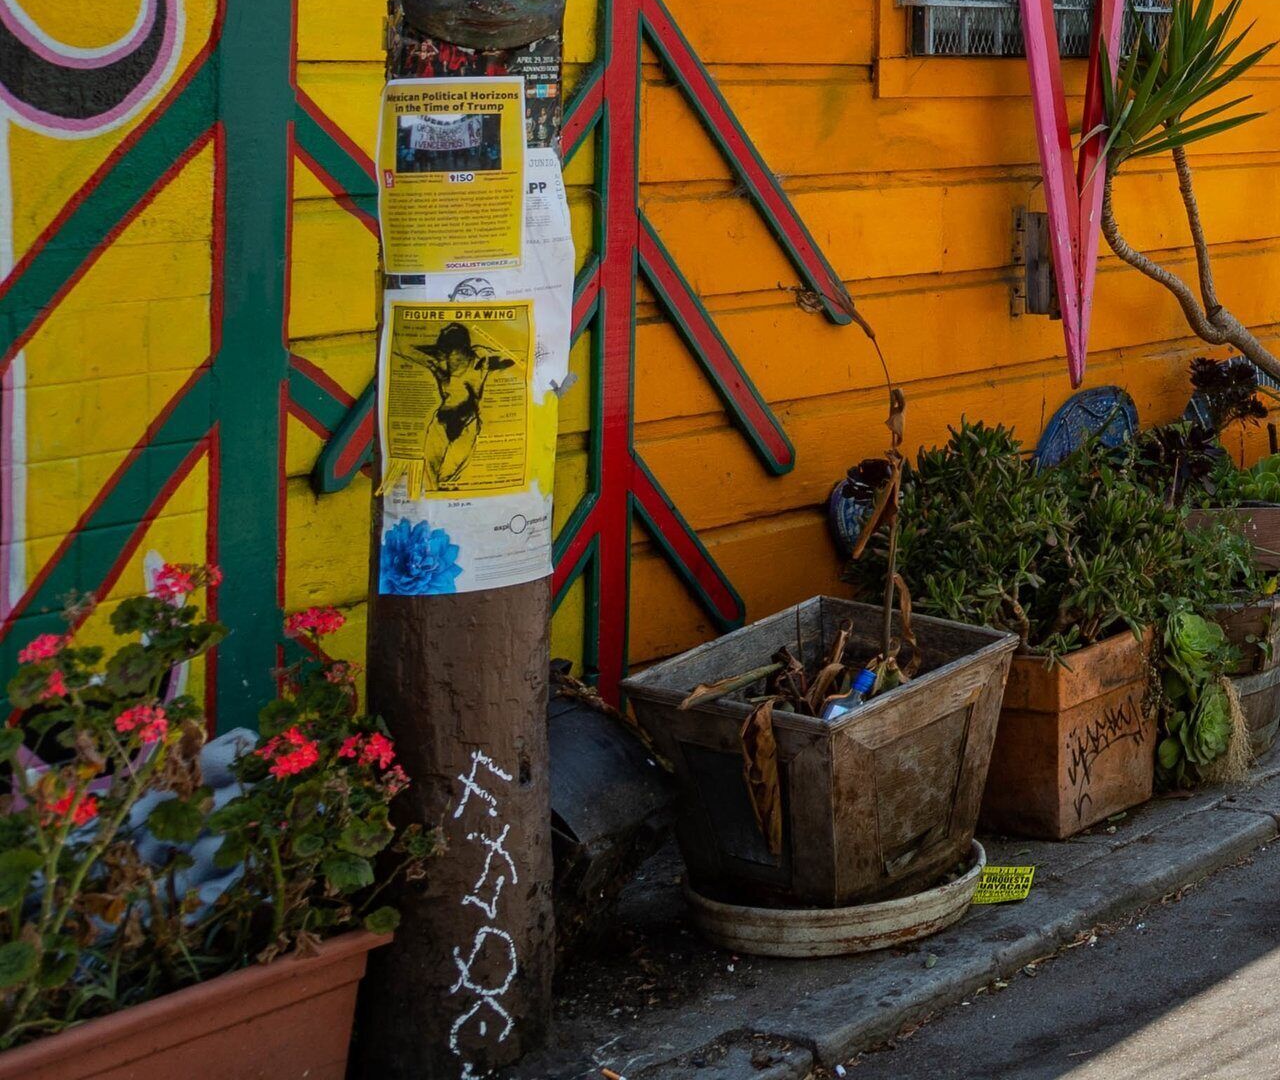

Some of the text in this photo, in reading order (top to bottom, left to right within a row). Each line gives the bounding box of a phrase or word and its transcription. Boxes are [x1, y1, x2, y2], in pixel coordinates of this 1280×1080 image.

[422, 92, 468, 101] Political
[470, 91, 519, 100] Horizons
[395, 102, 504, 113] in the Time of Trump
[405, 311, 514, 319] FIGURE DRAWING
